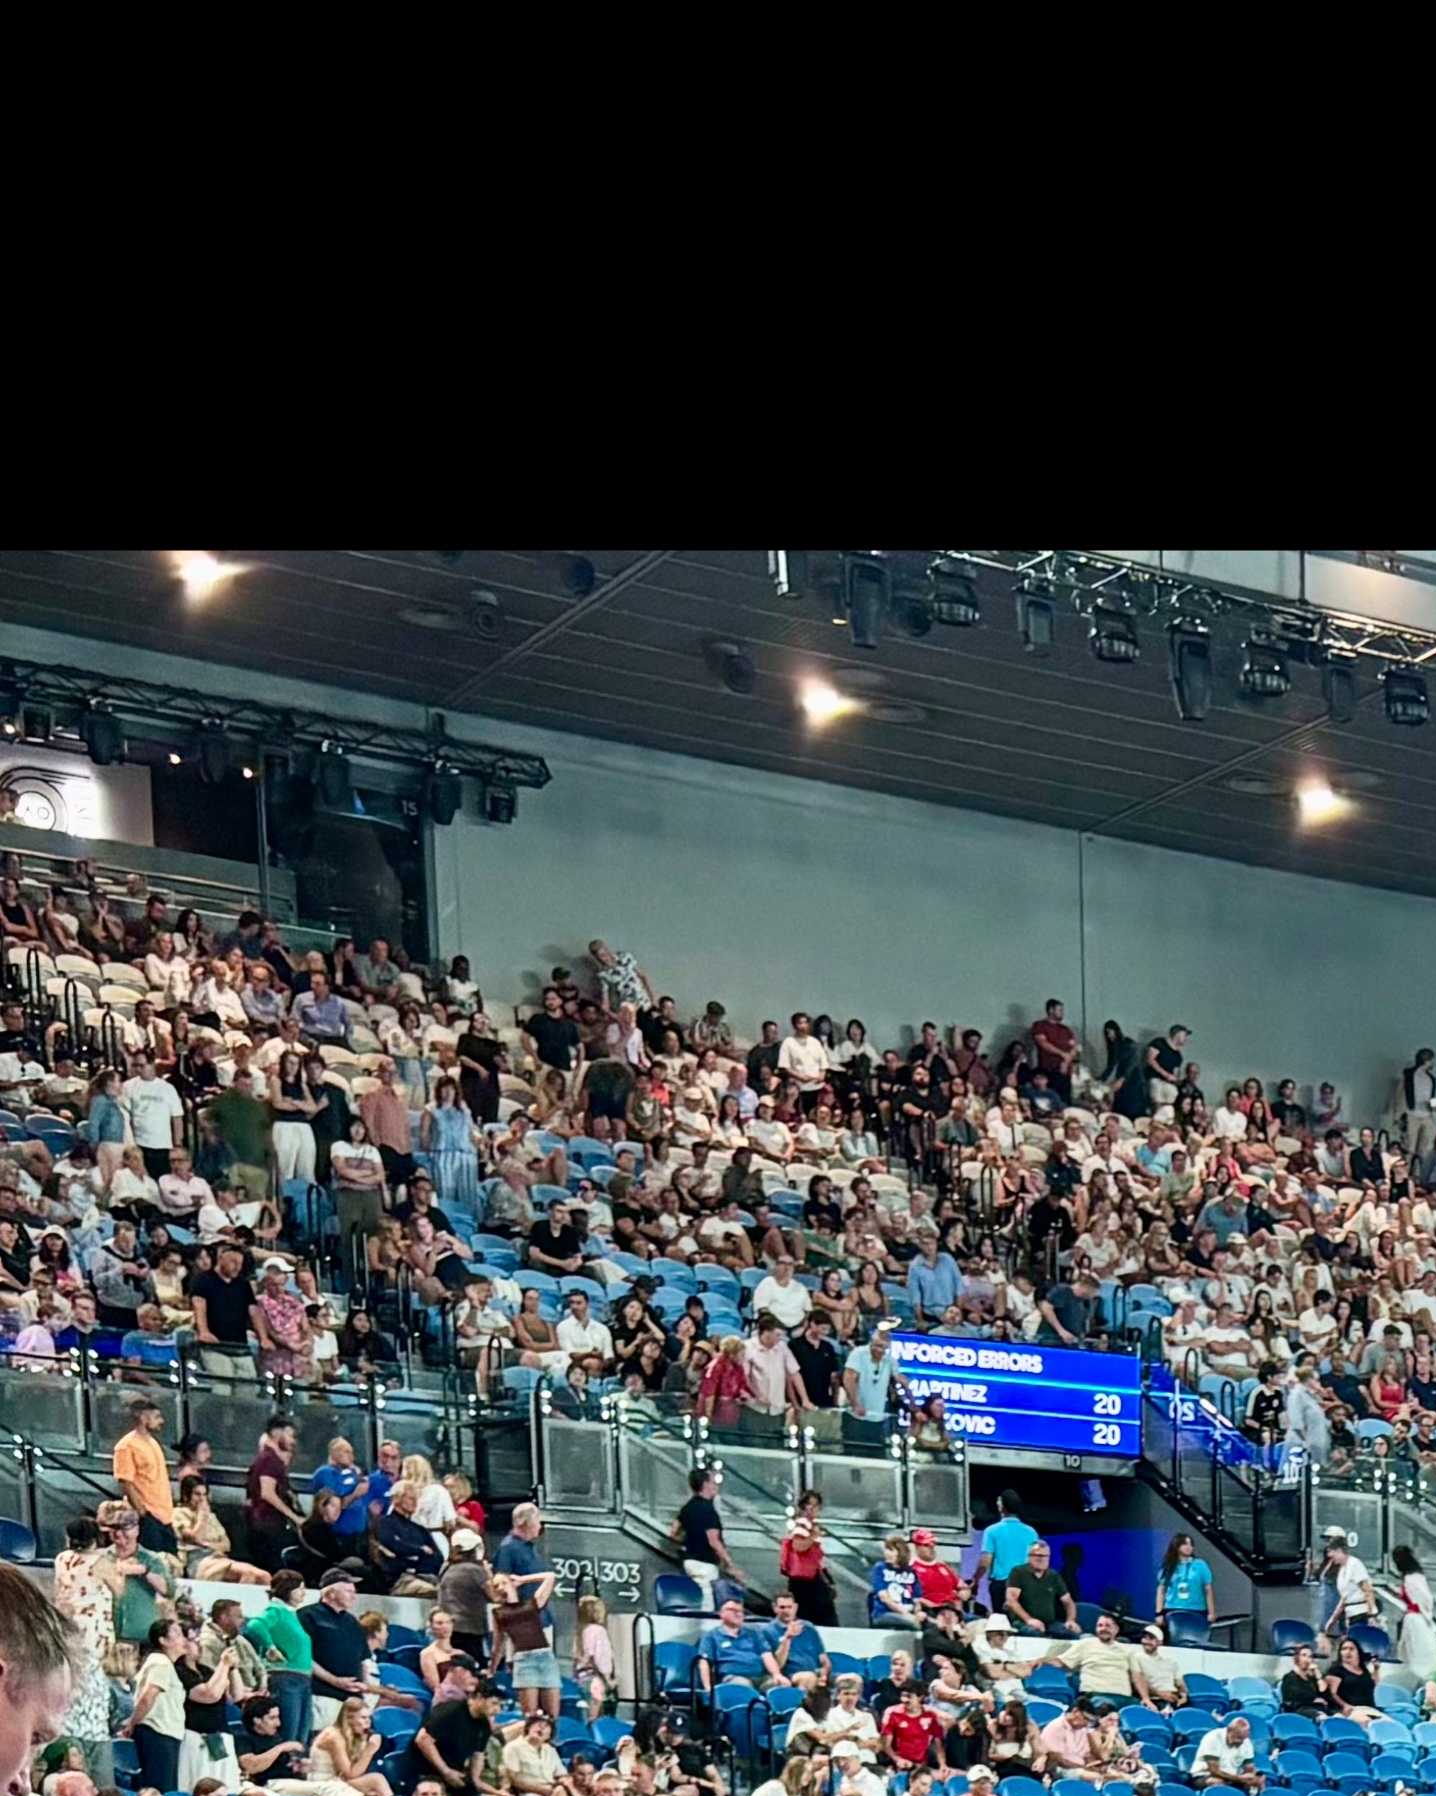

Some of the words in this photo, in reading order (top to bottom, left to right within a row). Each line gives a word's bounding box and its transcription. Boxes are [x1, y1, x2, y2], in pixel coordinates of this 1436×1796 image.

[977, 1349, 1043, 1374] ERRORS
[1092, 1393, 1121, 1416] 20
[1092, 1423, 1121, 1447] 20
[1065, 1454, 1081, 1467] 10
[600, 1561, 641, 1584] 303
